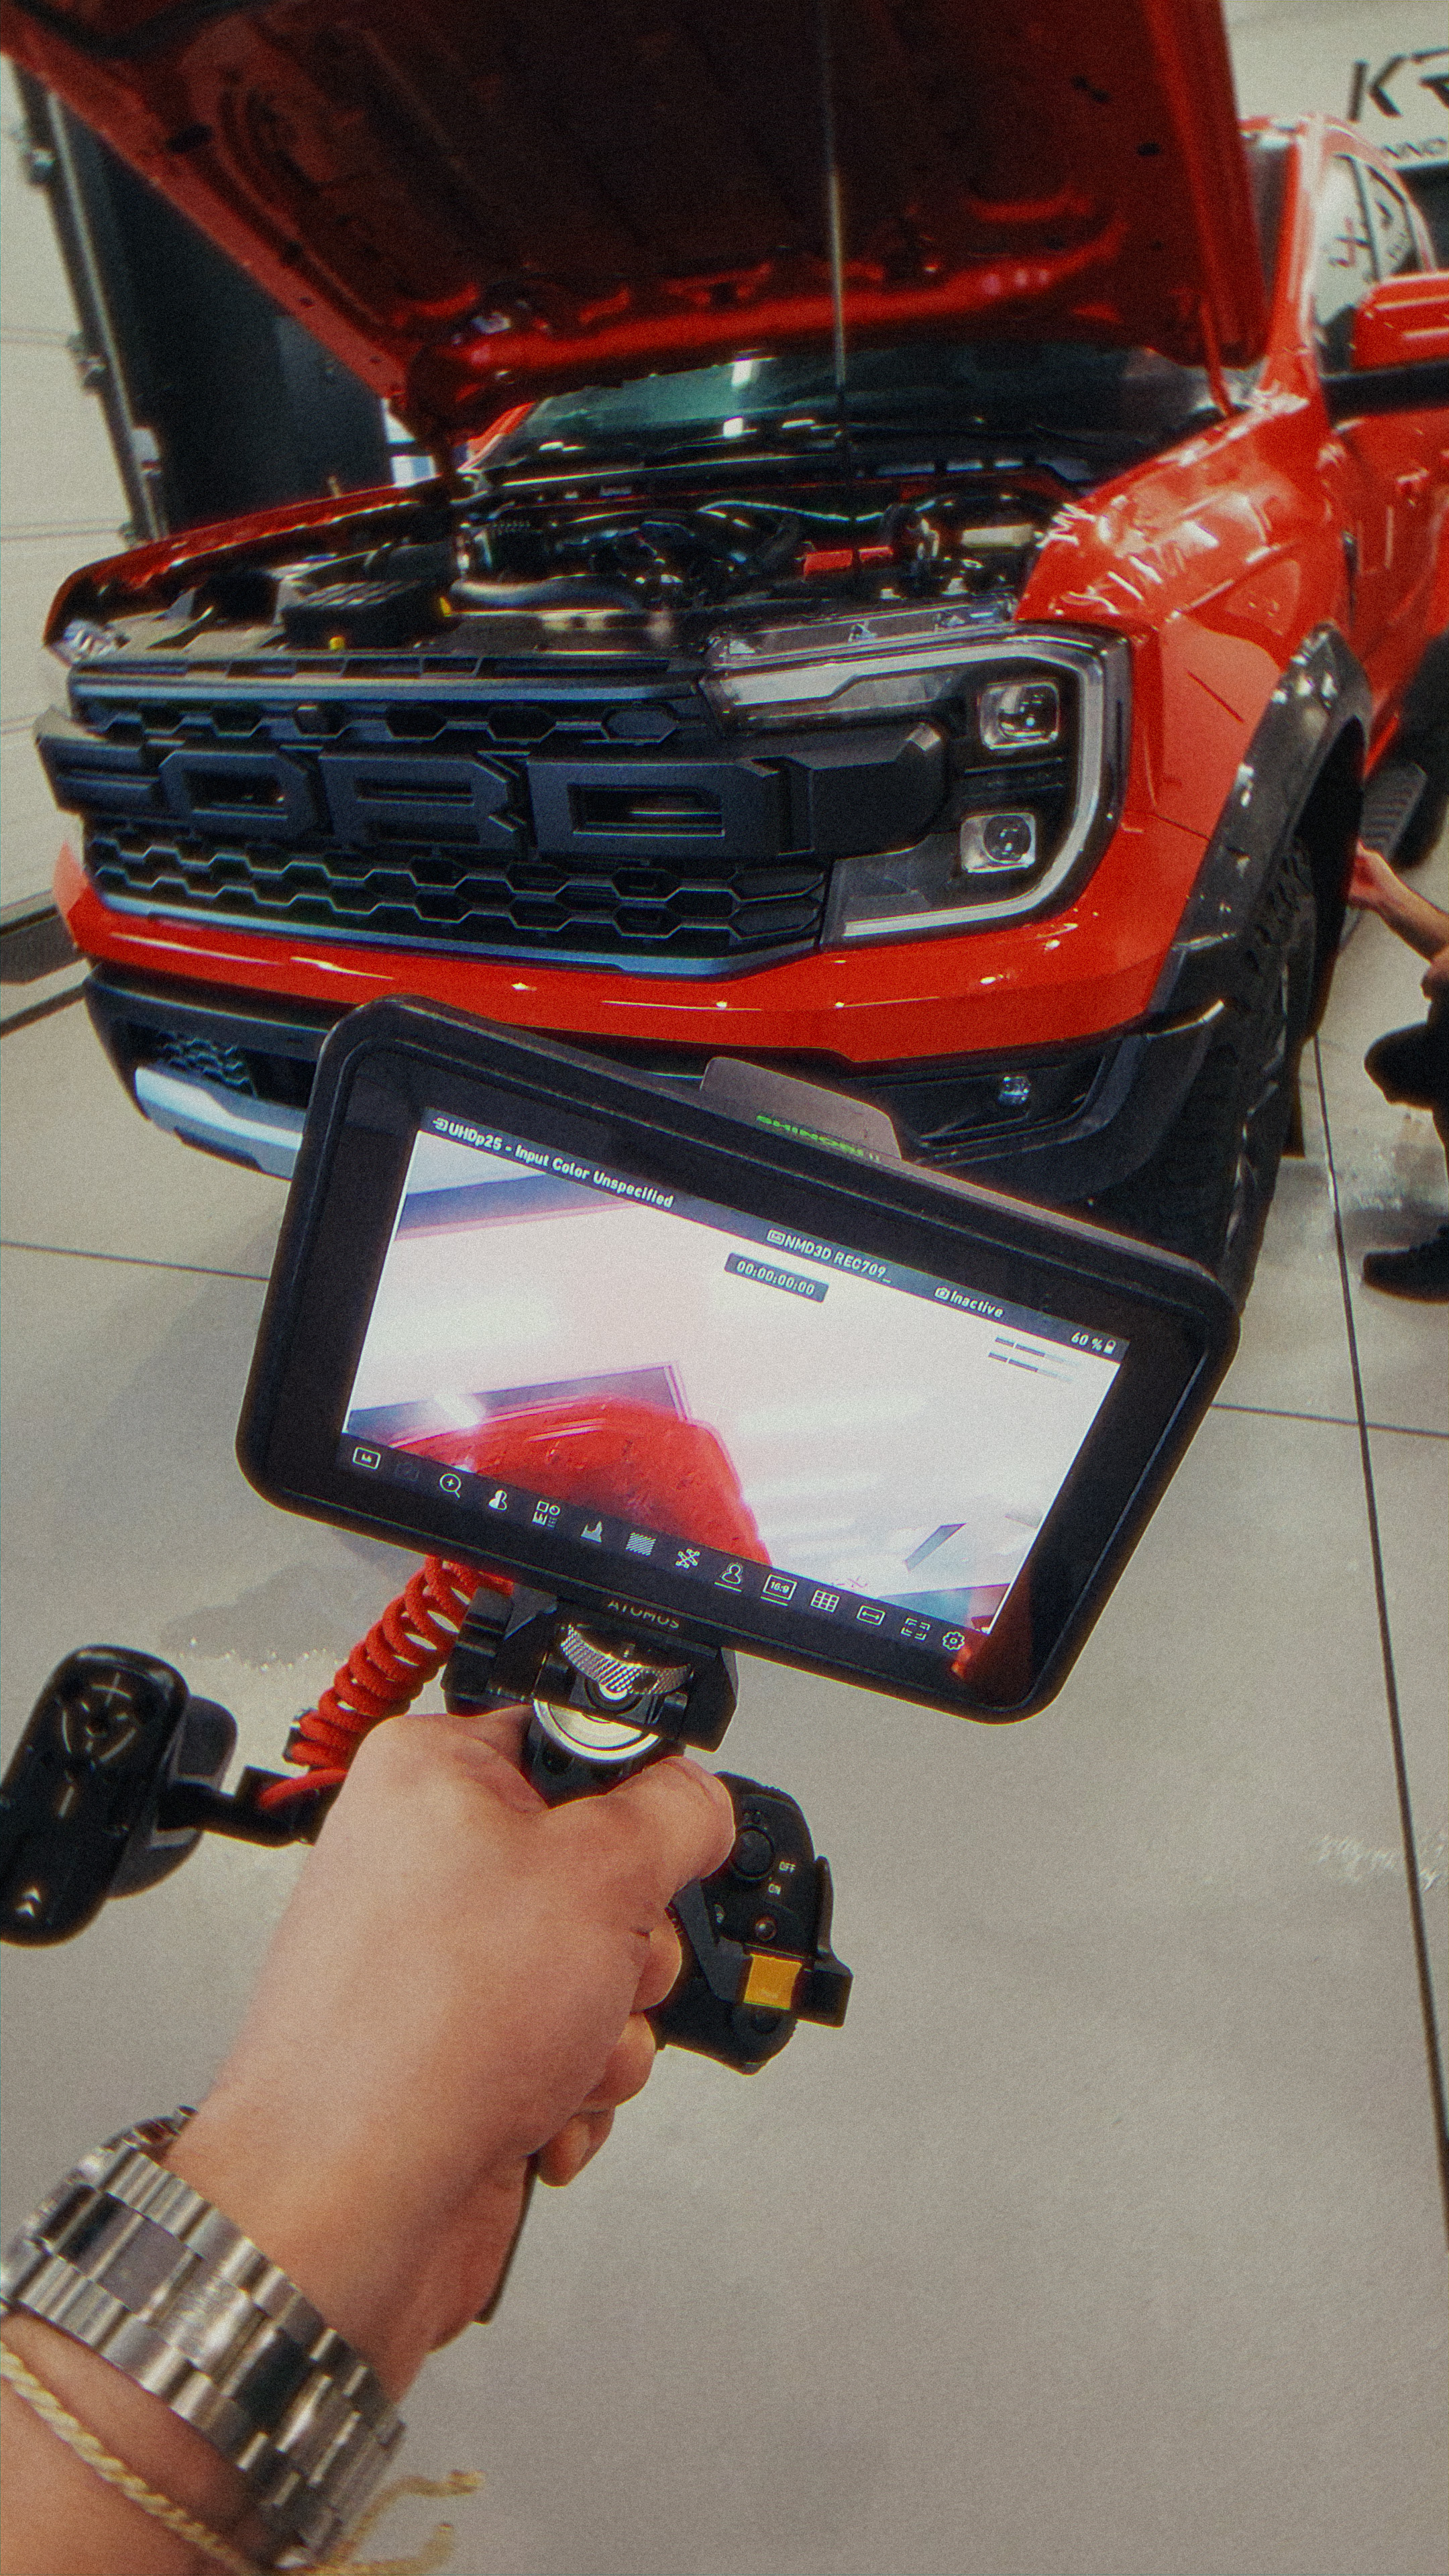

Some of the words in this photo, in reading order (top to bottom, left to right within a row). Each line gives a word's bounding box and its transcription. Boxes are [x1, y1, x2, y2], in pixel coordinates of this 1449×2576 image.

[447, 1122, 502, 1151] UHDp25
[515, 1144, 549, 1167] Input
[552, 1157, 591, 1179] Color
[593, 1171, 674, 1208] Unspecified
[784, 1234, 833, 1260] NMD3D
[737, 1259, 815, 1296] 00:00:00:00
[949, 1289, 1004, 1318] Inactive
[770, 1580, 790, 1594] 16:9
[778, 1860, 796, 1874] OFF
[767, 1882, 781, 1896] ON
